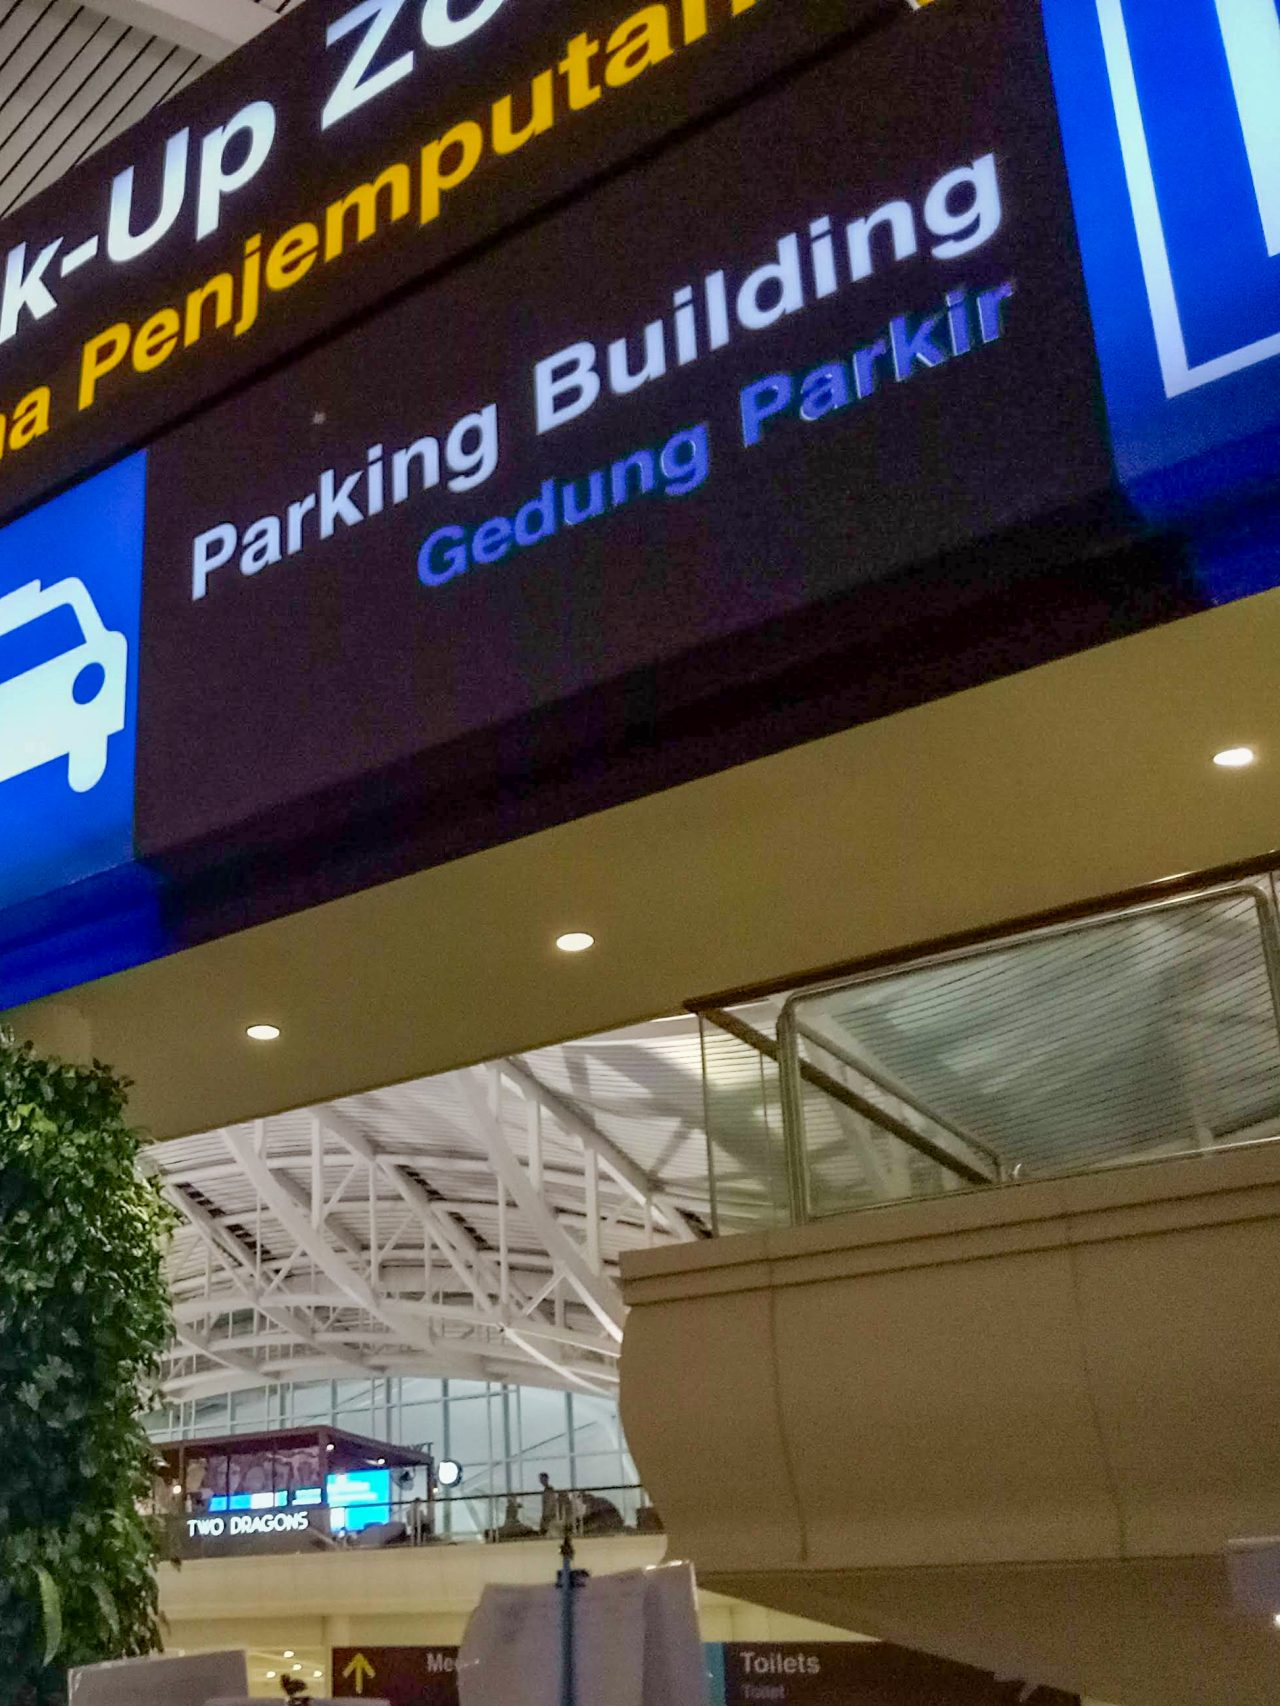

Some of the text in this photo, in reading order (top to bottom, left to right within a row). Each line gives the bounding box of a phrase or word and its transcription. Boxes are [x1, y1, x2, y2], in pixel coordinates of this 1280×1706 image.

[192, 152, 1003, 601] Parking Building
[418, 280, 1014, 587] Gedung Parkir
[187, 1510, 309, 1537] TWO DRAGONS
[740, 1651, 820, 1674] Toilets
